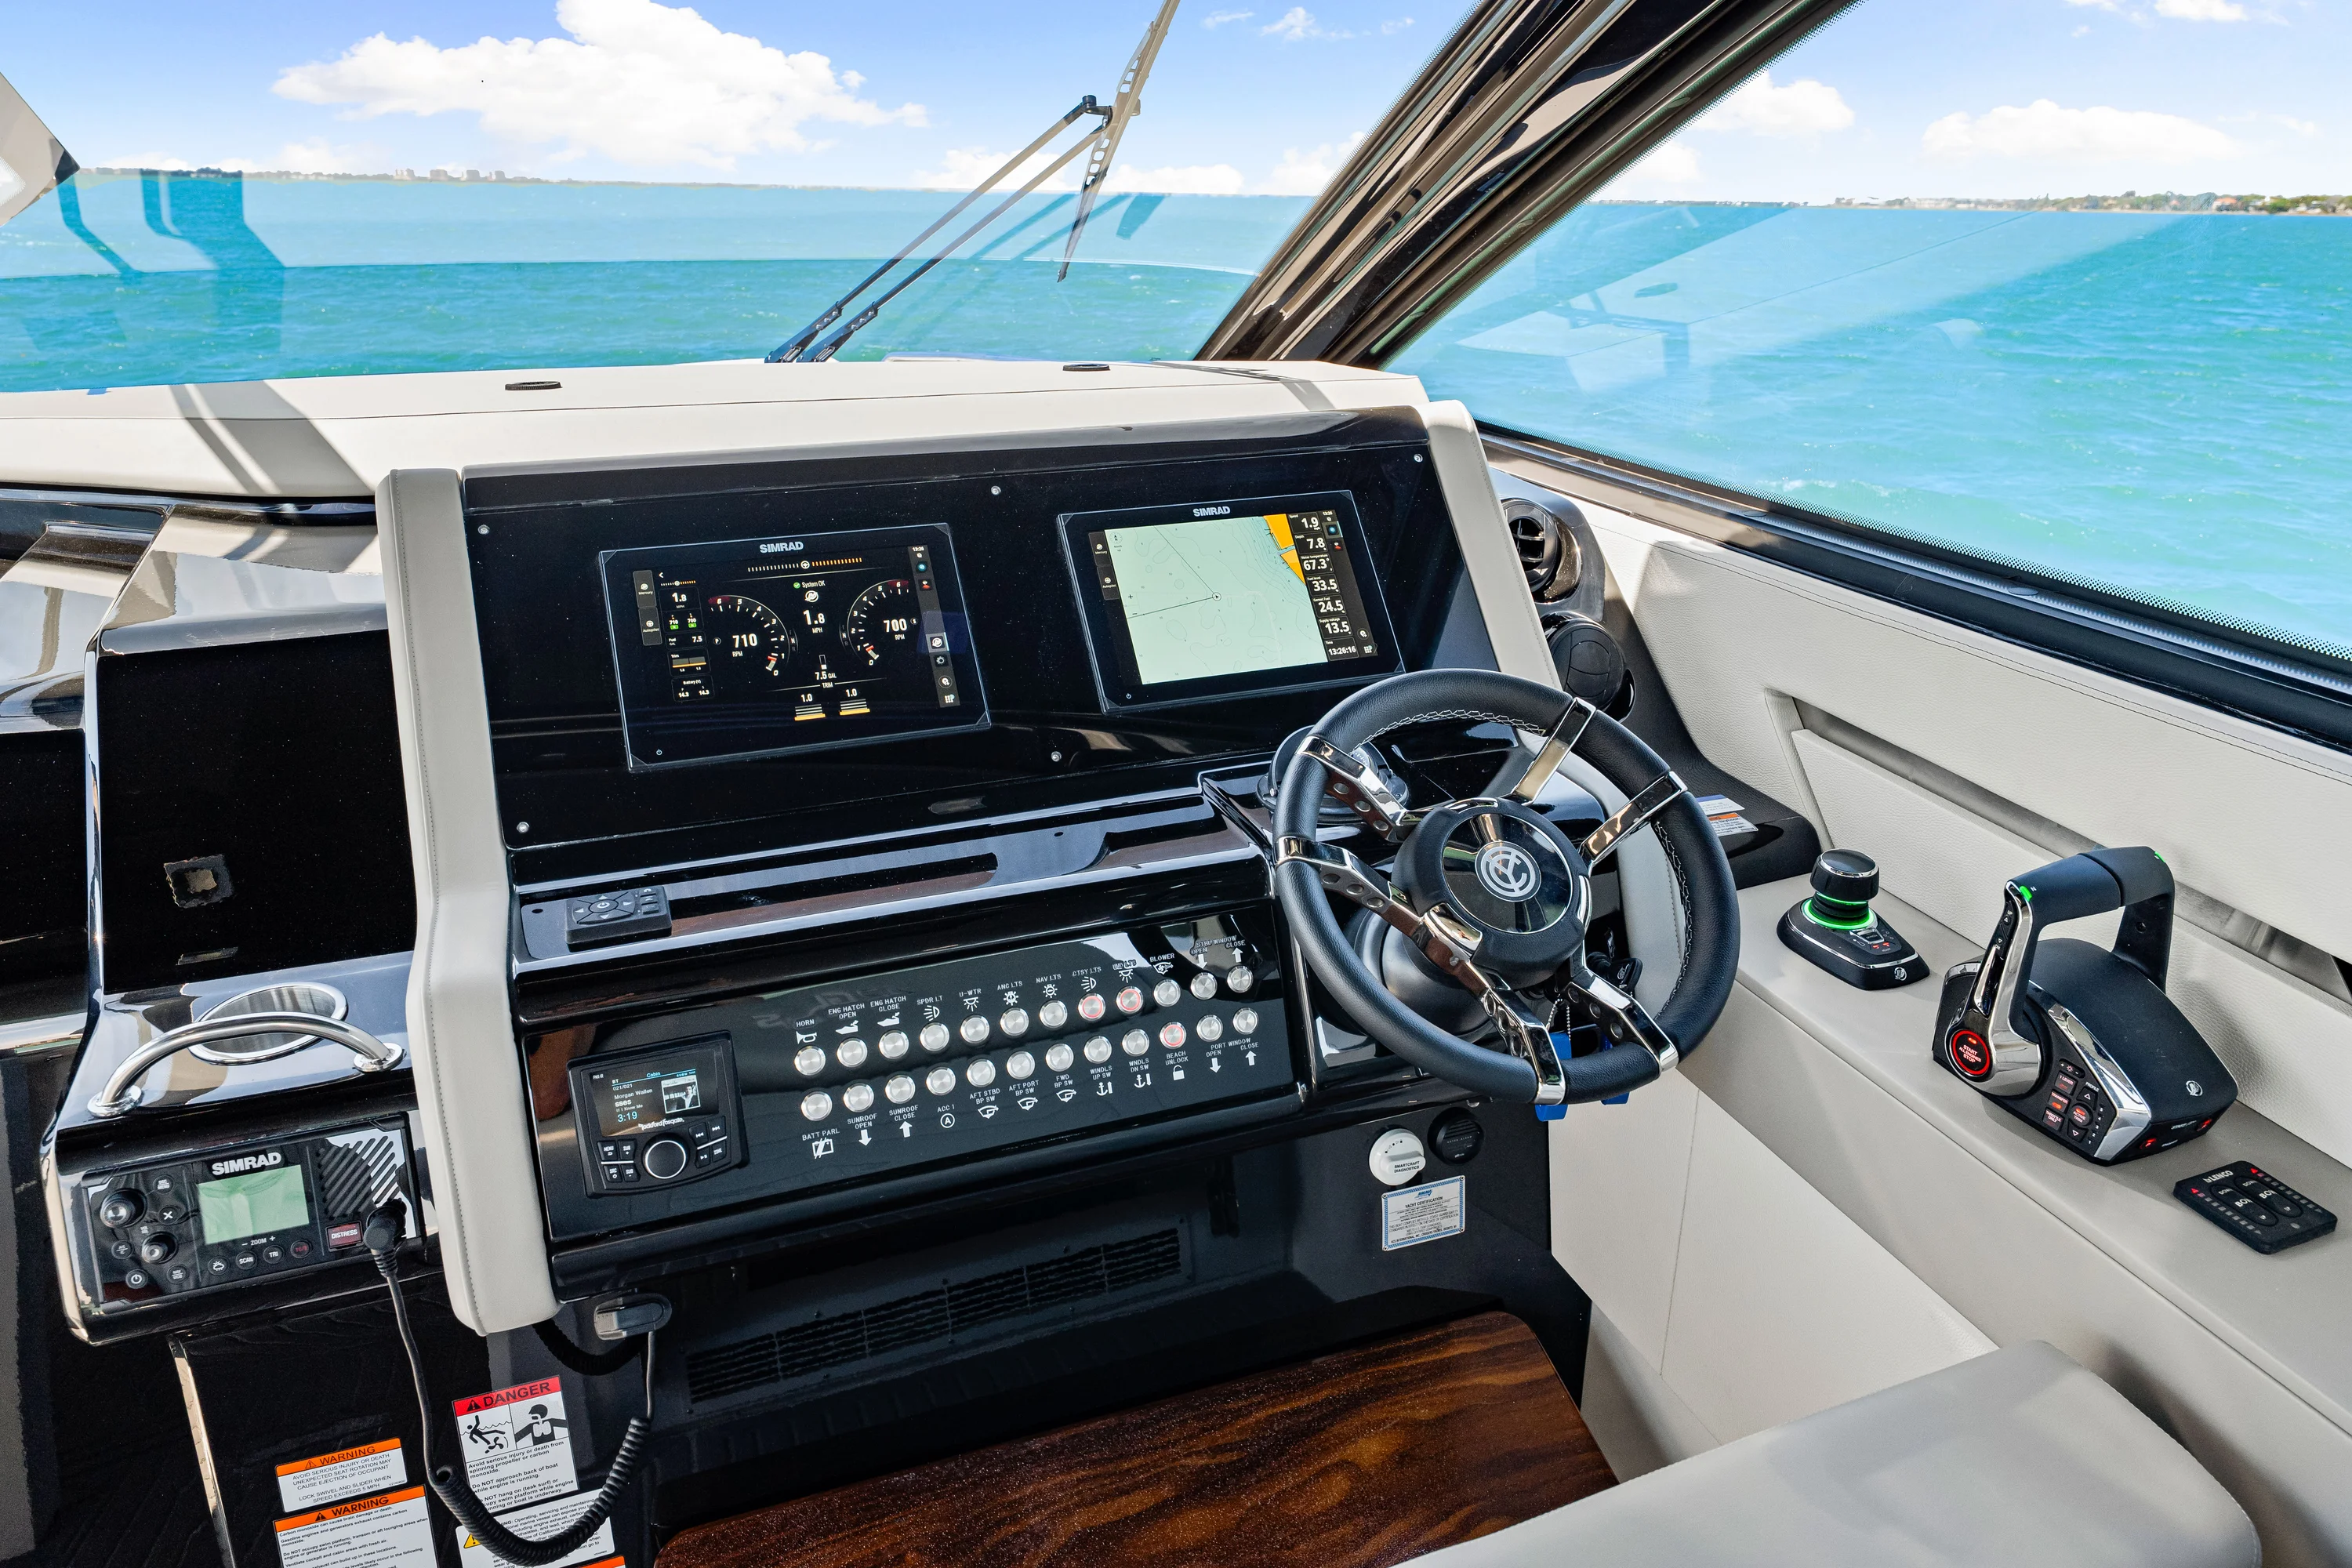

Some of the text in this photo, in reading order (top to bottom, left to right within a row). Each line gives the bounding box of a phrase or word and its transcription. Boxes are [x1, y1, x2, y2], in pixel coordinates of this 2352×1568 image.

[1193, 506, 1230, 517] SIMRAD
[1301, 517, 1319, 528] 1.9
[760, 541, 804, 554] SIMRAD
[1307, 538, 1325, 549] 7.8
[1312, 579, 1338, 591] 33.5
[1319, 600, 1344, 612] 24.5
[803, 610, 825, 625] 1.8
[884, 619, 907, 633] 700
[1325, 621, 1349, 633] 13.5
[732, 633, 757, 648] 710
[1329, 646, 1356, 655] 13:26:16
[815, 671, 827, 680] 7.5
[801, 693, 813, 702] 1.0
[846, 688, 857, 697] 1.0
[1214, 935, 1236, 945] WINDOW
[1149, 953, 1174, 963] BLOWER
[1073, 968, 1089, 977] CTSY
[959, 989, 982, 997] U-WTR
[885, 996, 906, 1005] HATCH
[843, 1004, 865, 1013] HATCH
[879, 1004, 900, 1012] CLOSE
[1228, 1038, 1251, 1047] WINDOW
[1240, 1042, 1259, 1051] CLOSE
[1167, 1051, 1186, 1059] BEACH
[1963, 1044, 1977, 1056] START
[1129, 1058, 1149, 1067] WNDLS
[1165, 1056, 1189, 1065] UNLOCK
[1963, 1053, 1976, 1063] STOP
[1090, 1065, 1112, 1074] WINDLS
[2063, 1076, 2074, 1086] LEVER
[2085, 1081, 2100, 1092] PROFILE
[983, 1088, 1000, 1097] STBD
[2051, 1091, 2068, 1105] TRANSFER
[889, 1105, 919, 1116] SUNROOF
[617, 1111, 637, 1123] 3:19
[848, 1113, 877, 1125] SUNROOF
[894, 1112, 916, 1121] CLOSE
[2073, 1111, 2086, 1121] ACTIVE
[855, 1121, 873, 1130] OPEN
[802, 1128, 840, 1142] BATT PARL
[212, 1152, 281, 1176] SIMRAD
[1394, 1160, 1420, 1169] SMARTCRAFT
[2211, 1171, 2234, 1181] LENCO
[1417, 1196, 1443, 1206] CERTIFICATION
[331, 1229, 358, 1240] DISTRESS
[483, 1381, 551, 1408] DANGER
[320, 1446, 376, 1465] WARNING
[486, 1456, 507, 1465] serious
[469, 1465, 494, 1474] spinning
[495, 1457, 521, 1468] propeller
[530, 1450, 549, 1458] carbon
[312, 1466, 338, 1475] SERIOUS
[339, 1461, 359, 1469] INJURY
[293, 1473, 332, 1486] UNEXPECTED
[350, 1462, 378, 1472] ROTATION
[297, 1482, 318, 1490] CAUSE
[319, 1475, 347, 1485] EJECTION
[358, 1465, 390, 1475] OCCUPANT
[470, 1469, 500, 1479] monoxide.
[495, 1472, 522, 1483] approach
[352, 1479, 372, 1488] SLIDER
[489, 1481, 509, 1490] engine
[517, 1474, 540, 1483] running.
[334, 1488, 361, 1497] EXCEEDS
[332, 1497, 389, 1517] WARNING
